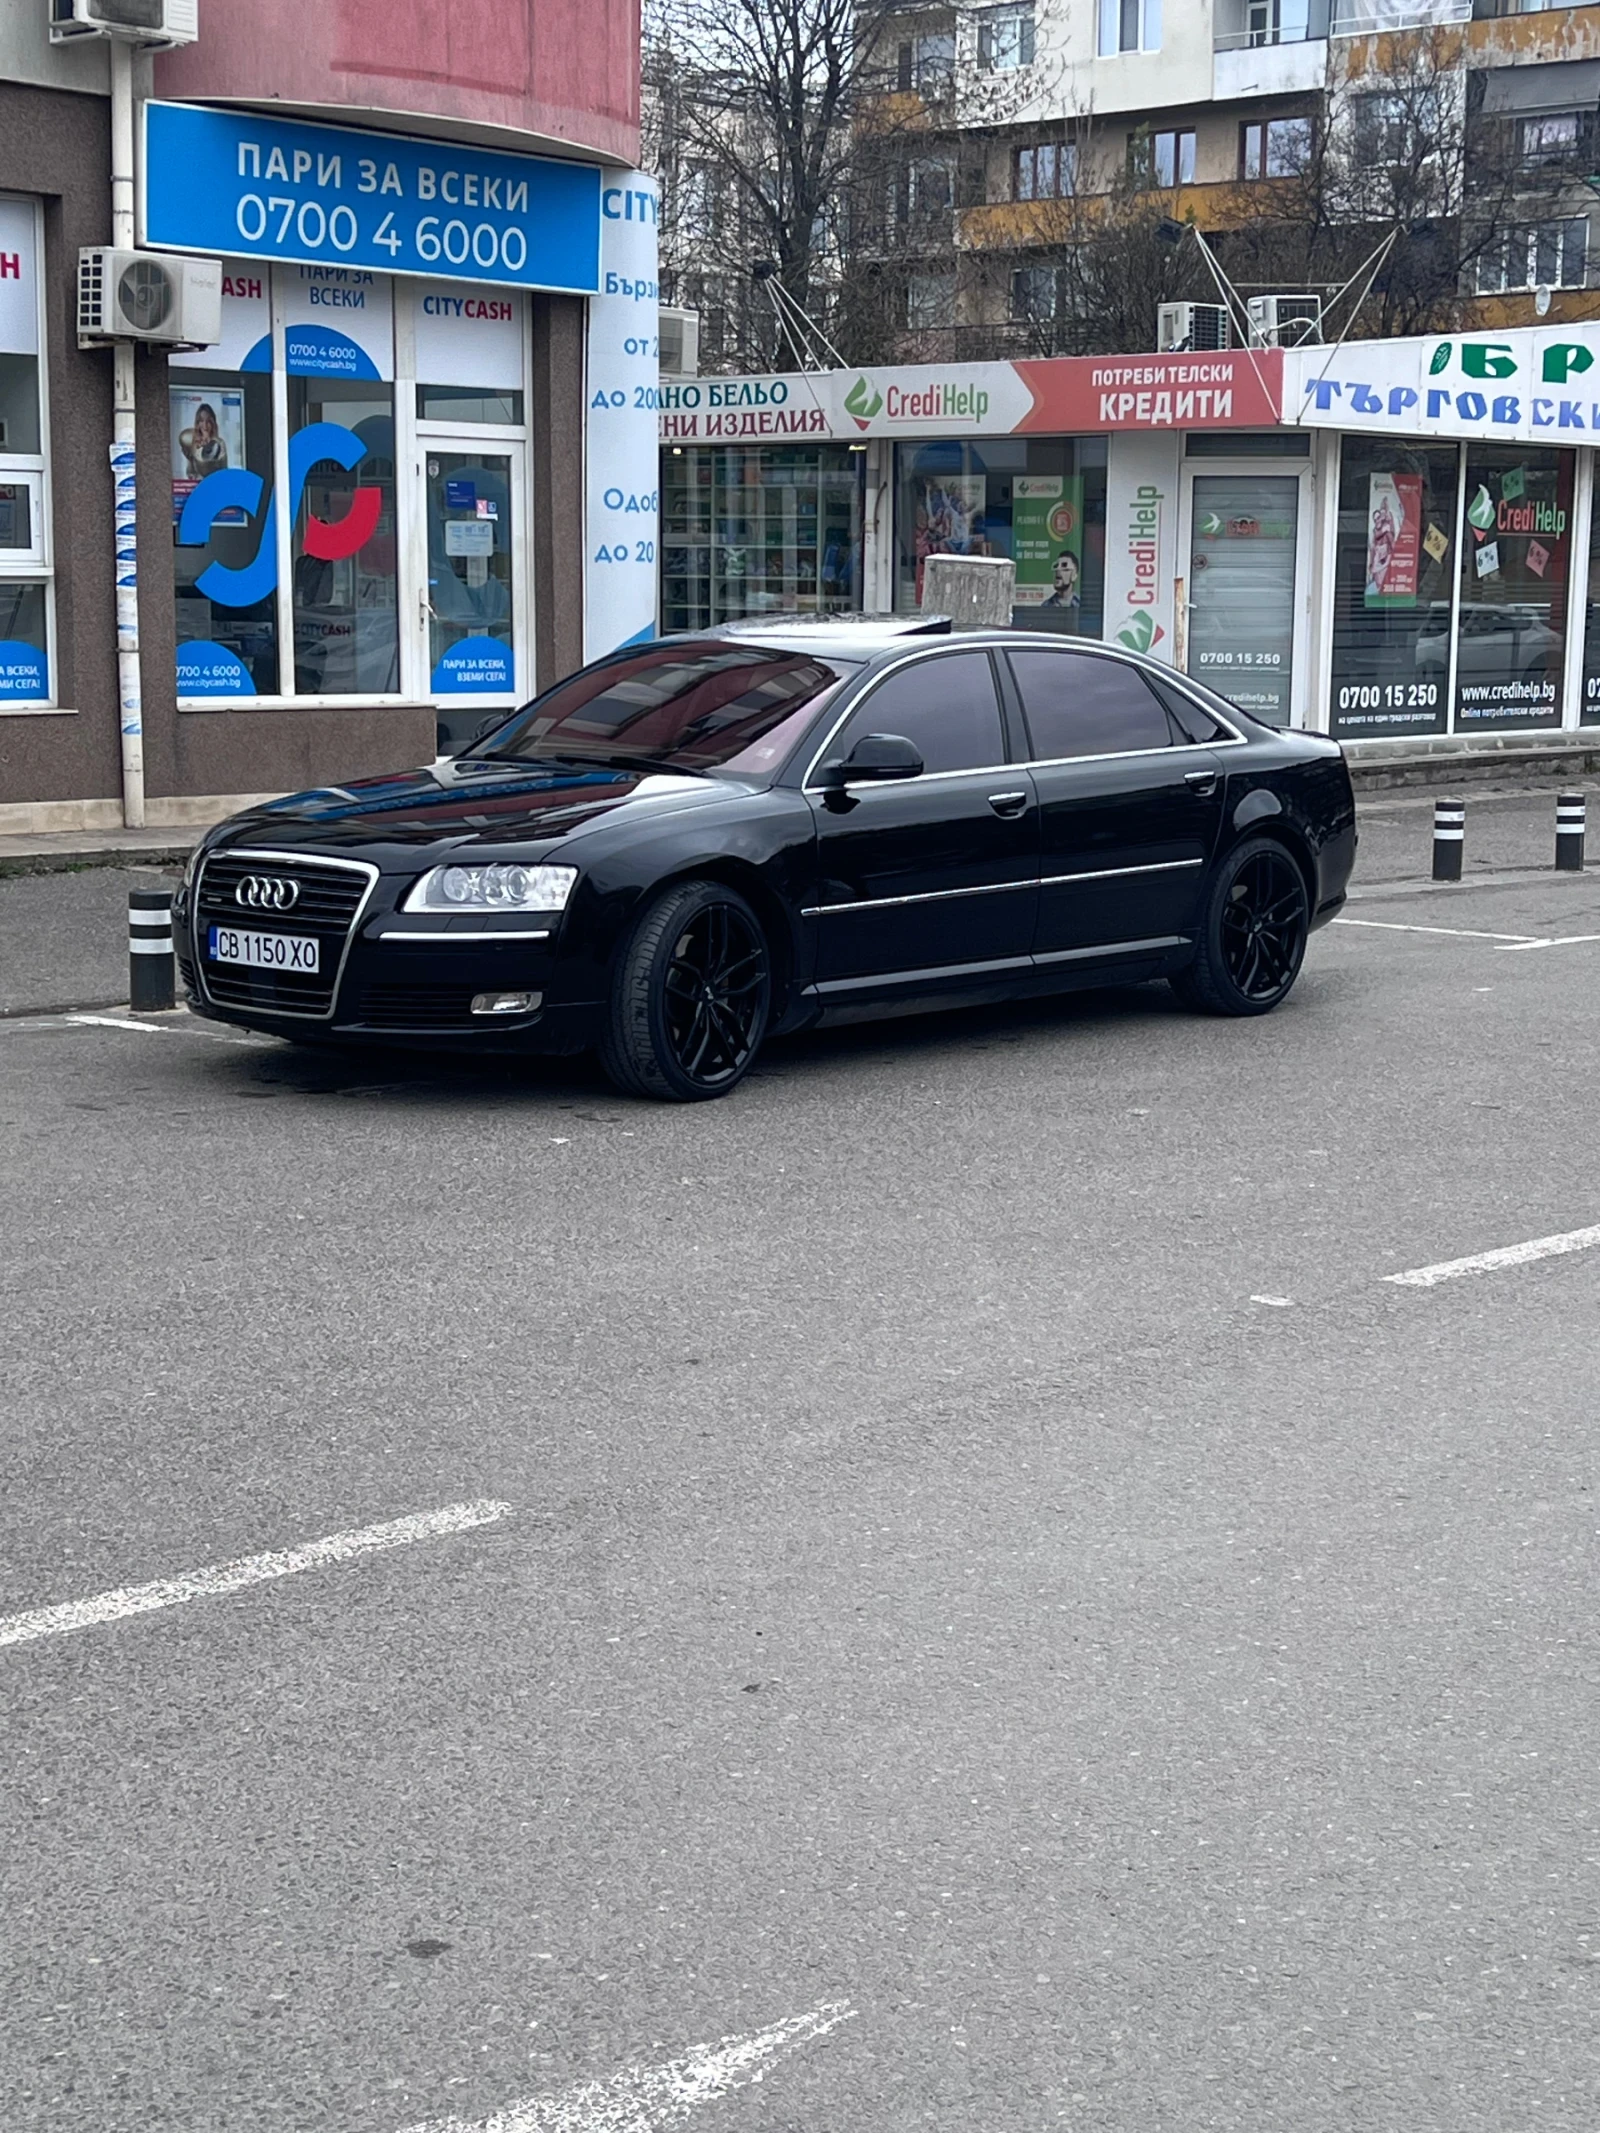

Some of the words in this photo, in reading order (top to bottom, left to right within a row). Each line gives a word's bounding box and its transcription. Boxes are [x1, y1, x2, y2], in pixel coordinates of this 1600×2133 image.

[238, 142, 341, 189] ПАРИ
[358, 160, 403, 197] ЗА
[418, 167, 528, 213] ВСЕКИ
[236, 193, 357, 251] 0700
[372, 212, 402, 257] 4
[415, 216, 528, 271] 6000
[310, 286, 365, 309] ВСЕКИ
[423, 296, 512, 321] CITYCASH
[289, 343, 317, 357] 0700
[319, 346, 327, 358] 4
[328, 347, 356, 360] 6000
[624, 338, 649, 357] от
[289, 357, 357, 372] www.citycash.bg
[591, 389, 626, 410] до
[709, 381, 788, 407] БЕЛЬО
[887, 383, 988, 423] CrediHelp
[1099, 390, 1232, 425] КРЕДИТИ
[705, 409, 826, 438] ИЗДЕЛИЯ
[1497, 501, 1565, 540] CrediHelp
[594, 544, 628, 563] до
[1127, 486, 1164, 604] CrediHelp
[202, 666, 210, 677] 4
[212, 665, 240, 677] 6000
[443, 659, 466, 669] ПАРИ
[467, 659, 477, 669] ЗА
[1200, 653, 1233, 664] 0700
[1237, 653, 1252, 664] 15
[1255, 653, 1280, 665] 250
[457, 672, 484, 682] ВЗЕМИ
[1339, 686, 1380, 709] 0700
[1385, 685, 1404, 707] 15
[1408, 684, 1437, 706] 250
[1461, 680, 1555, 702] www.credihelp.bg
[244, 935, 285, 964] 1150
